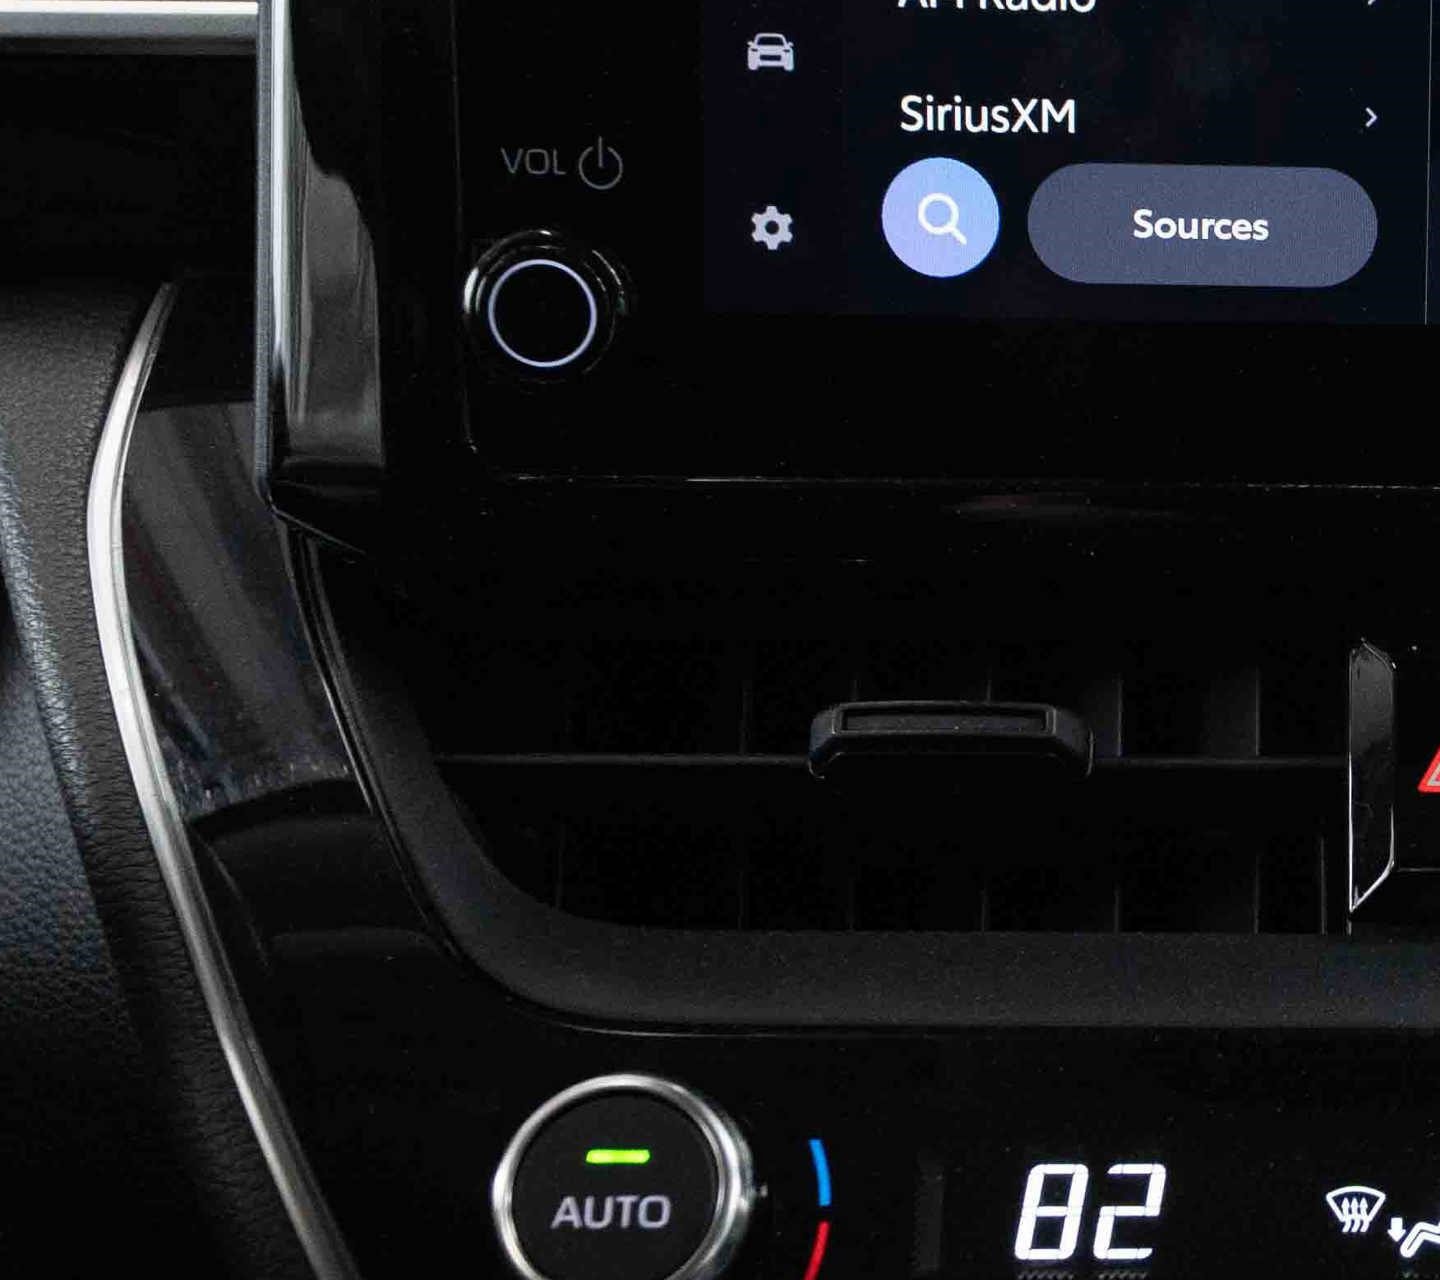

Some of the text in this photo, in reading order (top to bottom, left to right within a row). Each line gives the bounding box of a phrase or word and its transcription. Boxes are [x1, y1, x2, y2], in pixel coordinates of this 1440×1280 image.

[900, 94, 1076, 134] SiriusXM
[500, 147, 566, 176] VOL
[1133, 208, 1269, 241] Sources
[551, 1194, 672, 1230] AUTO
[1014, 1162, 1167, 1261] 82
